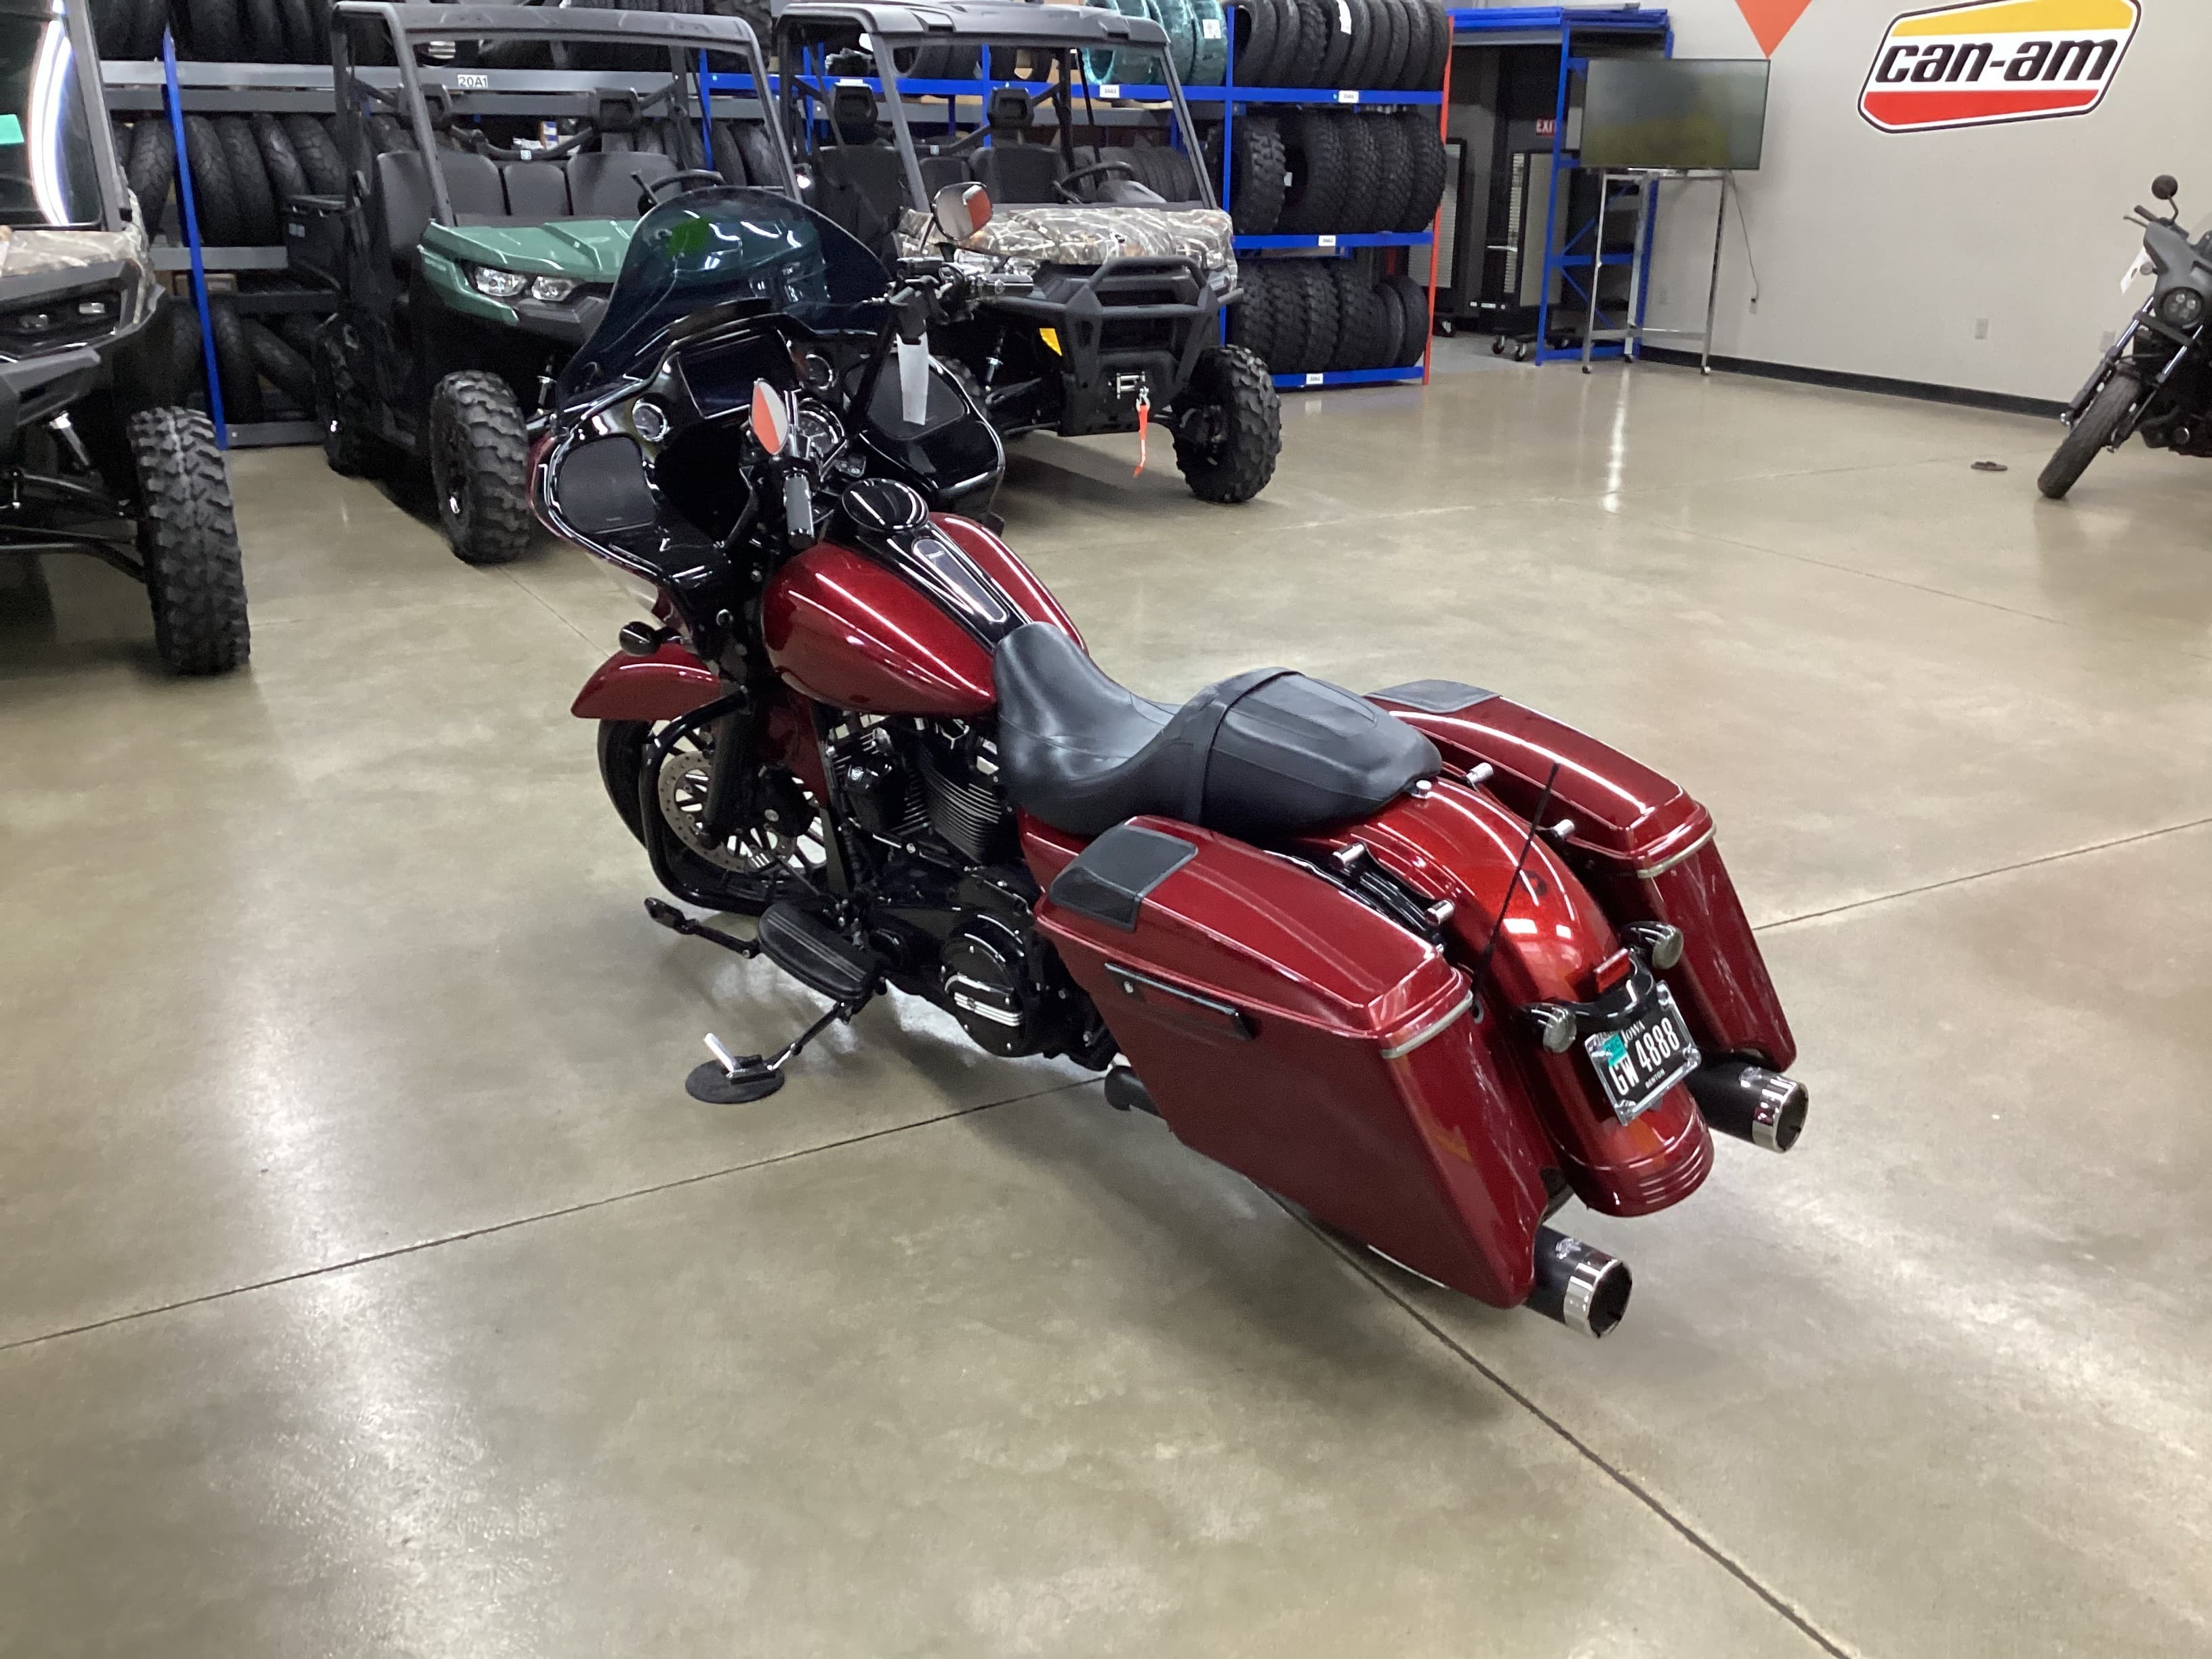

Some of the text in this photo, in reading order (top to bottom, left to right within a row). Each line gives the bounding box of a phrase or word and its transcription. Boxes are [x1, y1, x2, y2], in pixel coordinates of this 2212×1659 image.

[459, 76, 487, 87] 20A1
[1875, 39, 2118, 83] can-am
[1609, 1017, 1680, 1096] GW 4888
